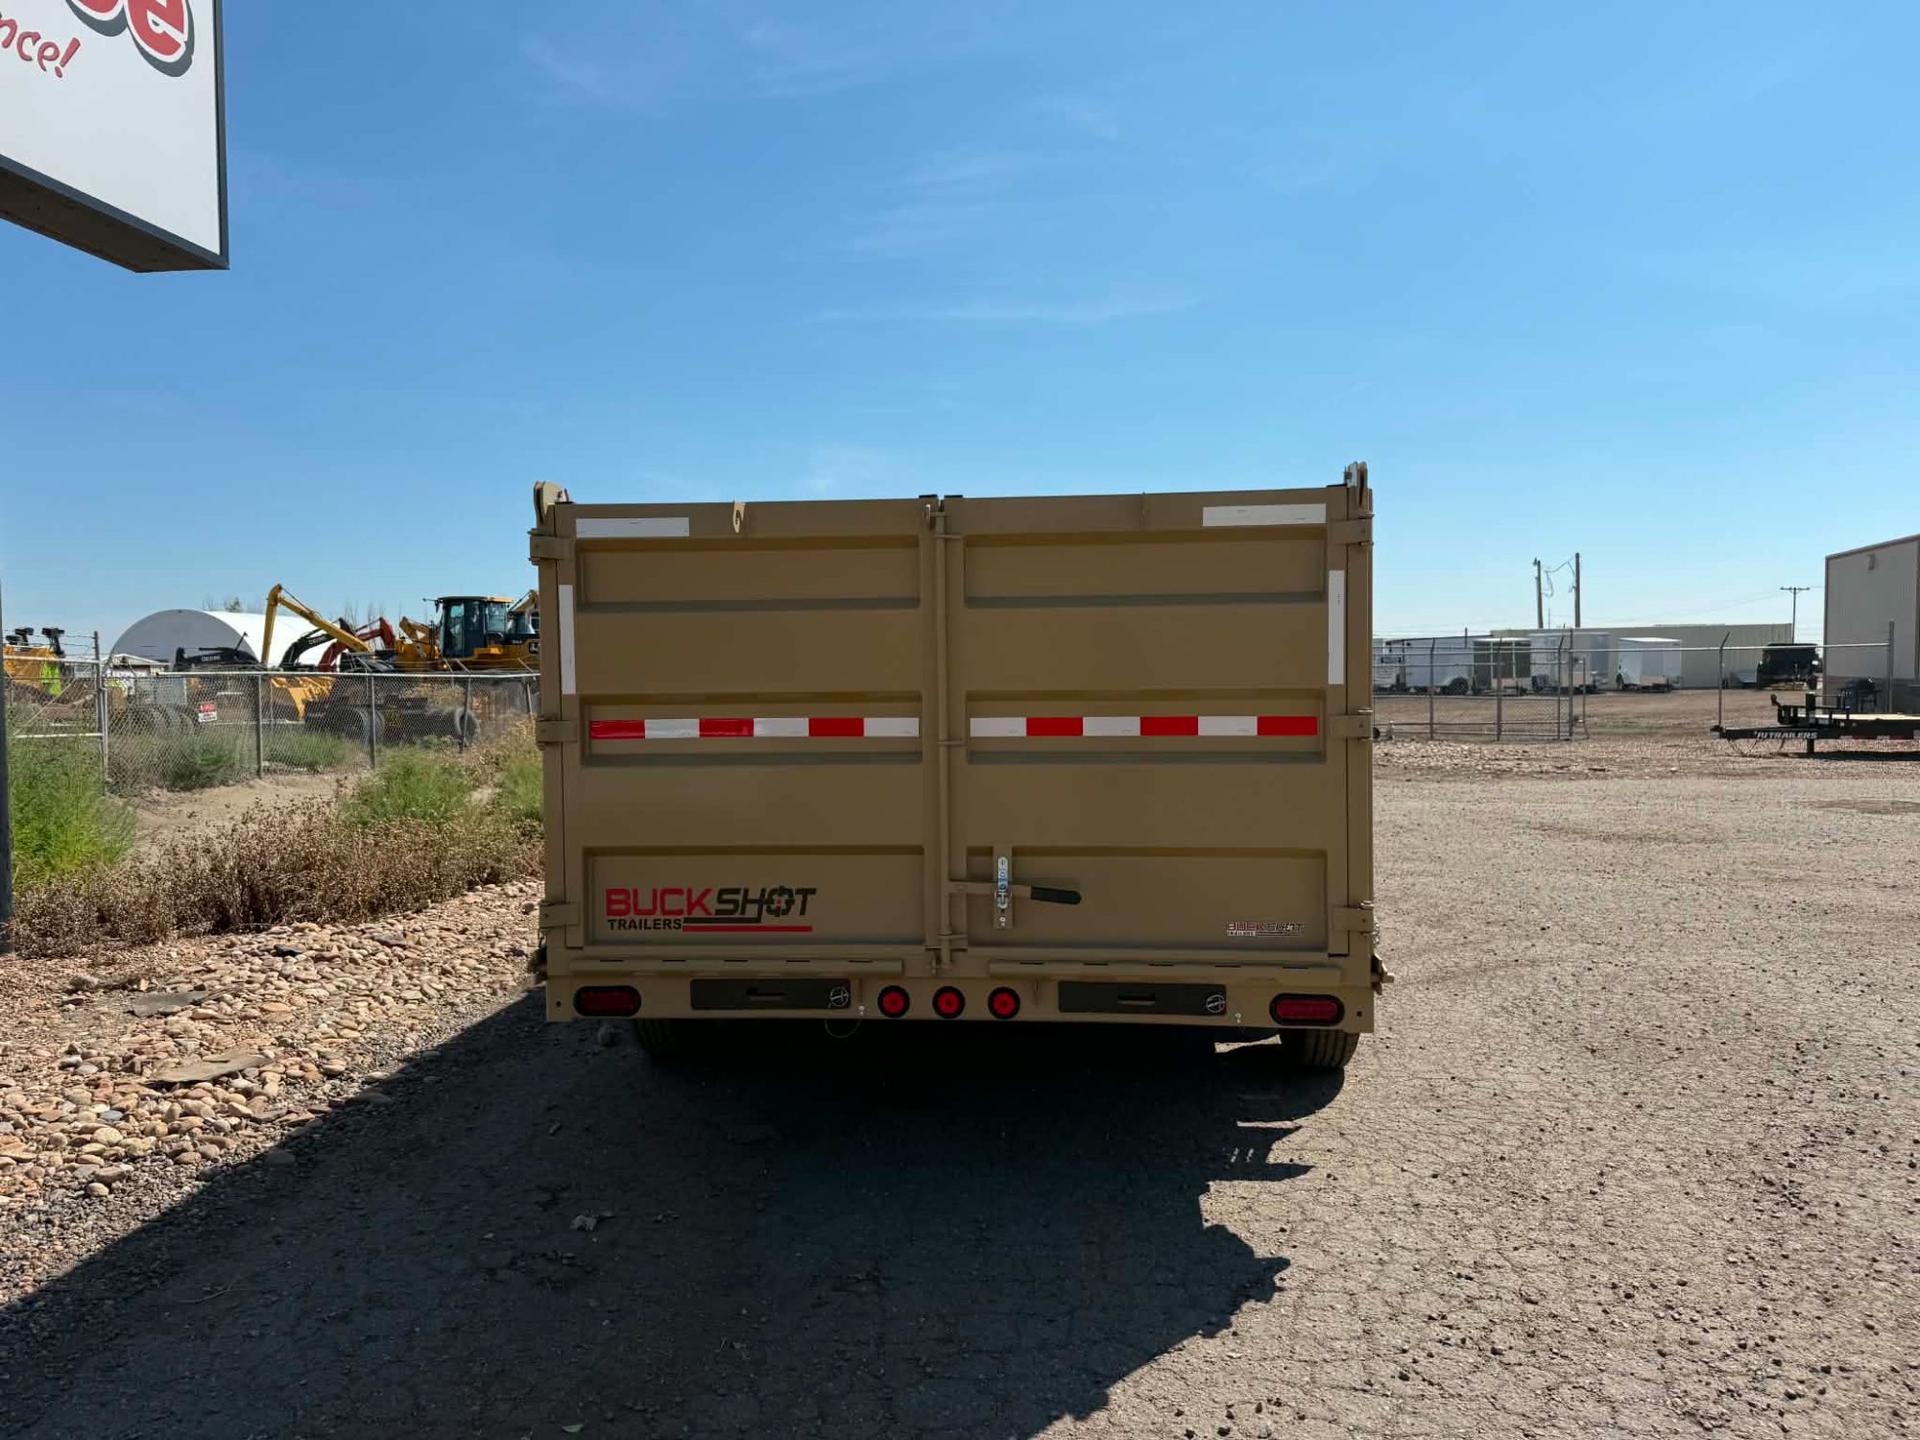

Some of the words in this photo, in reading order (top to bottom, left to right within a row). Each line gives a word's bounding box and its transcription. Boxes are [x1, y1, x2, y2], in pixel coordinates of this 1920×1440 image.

[1769, 731, 1818, 739] TRAILERS
[605, 886, 817, 918] BUCKSHOT
[608, 918, 682, 930] TRAILERS
